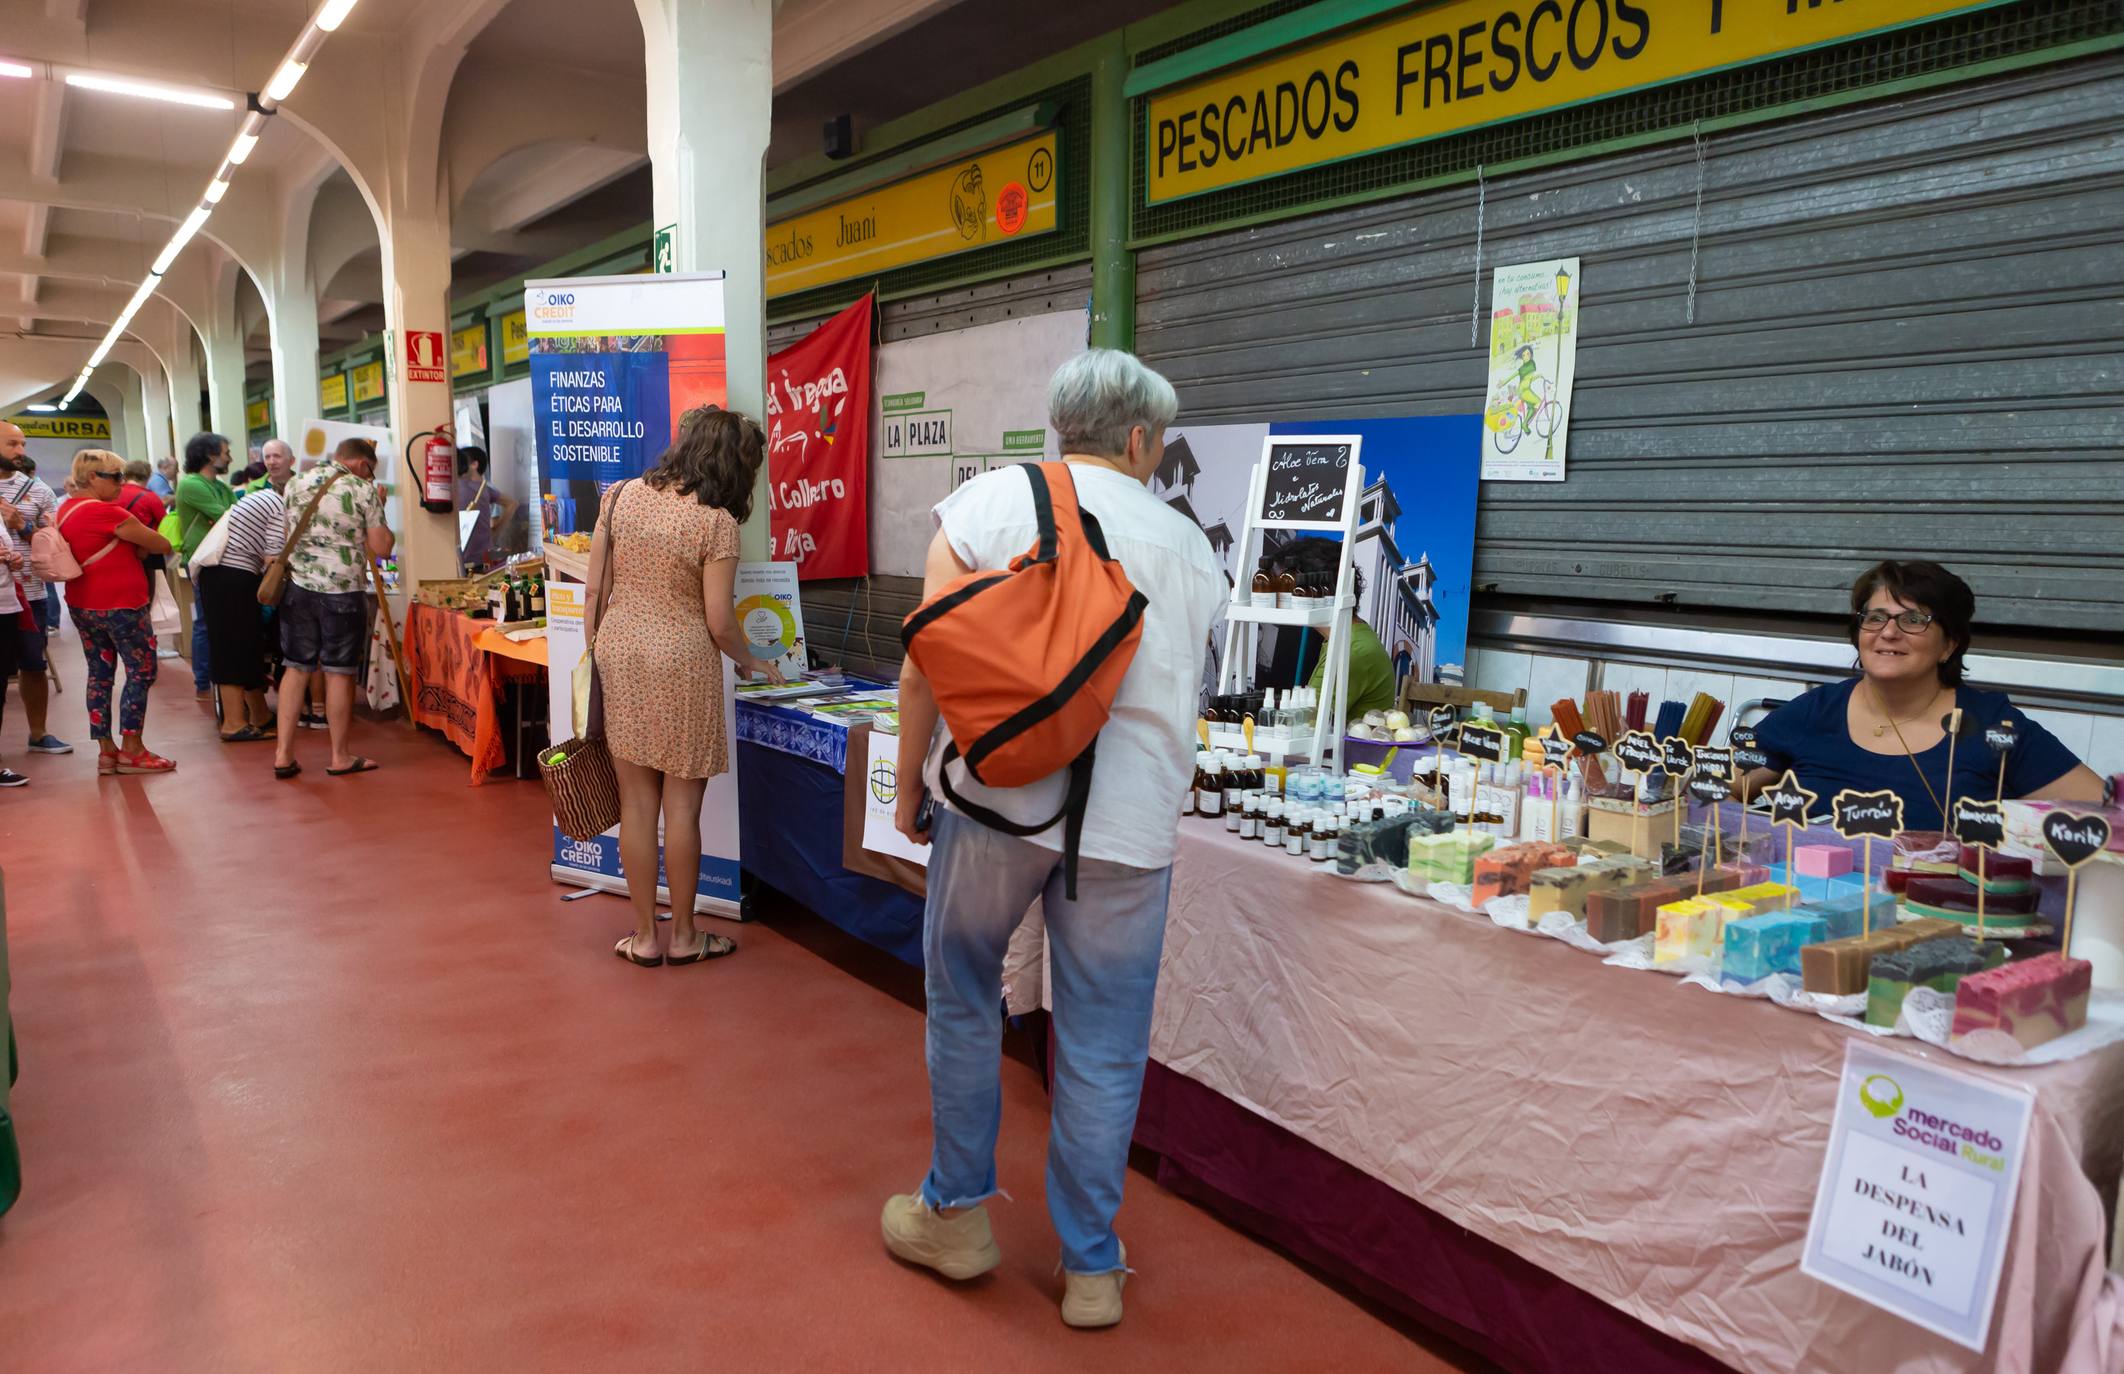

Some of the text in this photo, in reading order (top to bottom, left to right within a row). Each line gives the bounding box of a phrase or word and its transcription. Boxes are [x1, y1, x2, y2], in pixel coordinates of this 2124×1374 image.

[1158, 0, 1651, 179] PESCADOS FRESCOS
[1034, 161, 1044, 178] 11
[766, 206, 876, 267] scados Juani
[548, 294, 575, 305] OIKO
[534, 306, 576, 318] CREDIT
[409, 369, 444, 381] EXTINTOR
[550, 371, 606, 388] FINANZAS
[551, 393, 623, 413] ÉTICAS PARA
[552, 420, 645, 438] EL DESARROLLO
[888, 421, 946, 448] LA PLAZA
[553, 445, 621, 463] SOSTENIBLE
[1272, 450, 1329, 471] Aloe Vera
[1301, 488, 1343, 512] Naturales
[1775, 791, 1804, 810] Argan
[2051, 823, 2104, 848] Karité
[561, 849, 602, 867] CREDIT
[574, 841, 602, 855] OIKO
[1907, 1107, 2002, 1151] mercado
[1893, 1117, 2005, 1172] Social Rural
[1901, 1165, 1927, 1189] LA
[1854, 1178, 1966, 1237] DESPENSA
[1881, 1219, 1924, 1250] DEL
[1862, 1244, 1934, 1287] JABÓN
